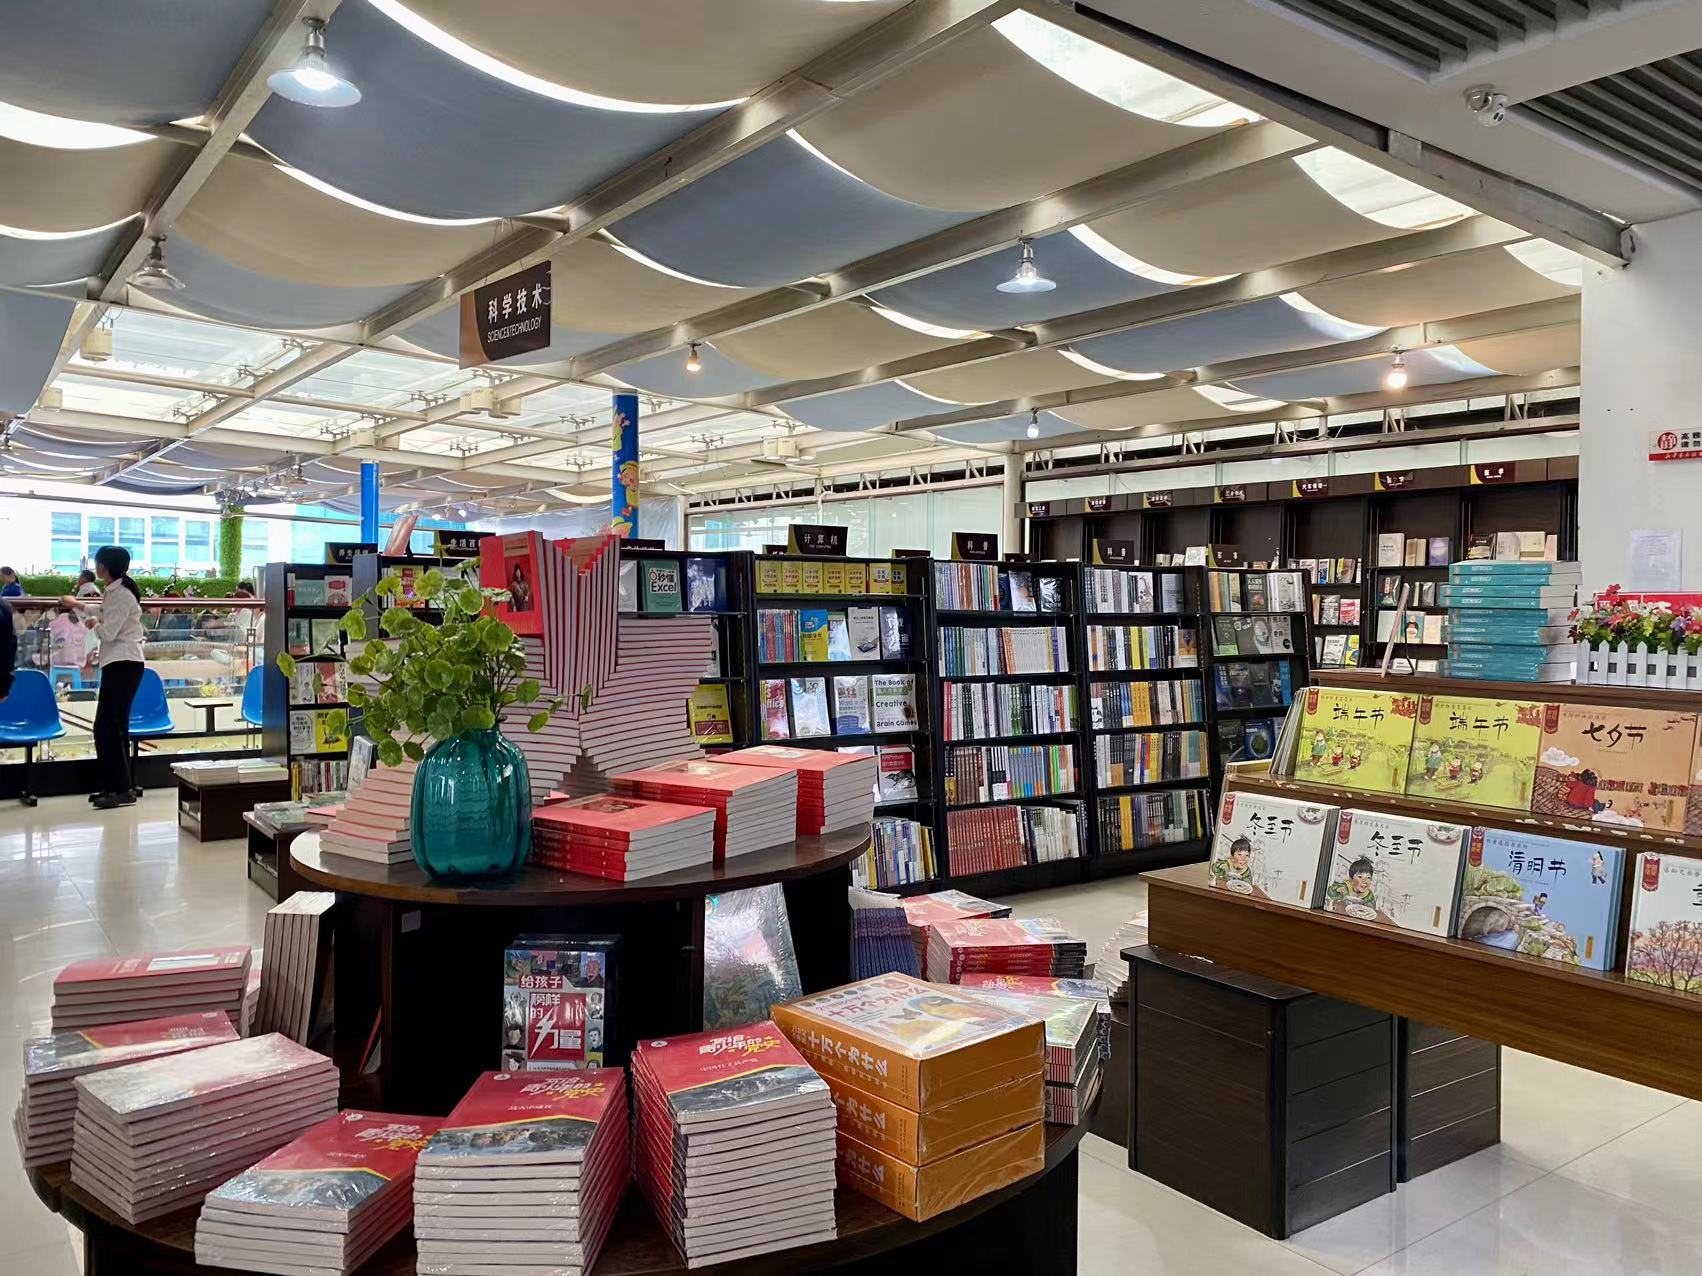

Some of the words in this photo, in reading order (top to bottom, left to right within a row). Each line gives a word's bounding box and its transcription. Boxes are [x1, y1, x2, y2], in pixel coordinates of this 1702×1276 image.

[488, 283, 542, 324] 科学技术
[450, 538, 480, 548] 生活百
[804, 534, 838, 545] 计算机
[651, 581, 677, 593] Excel
[875, 700, 908, 708] Creative
[1333, 703, 1384, 730] 端午节
[876, 719, 895, 727] Brain
[1449, 712, 1509, 740] 端午节
[1581, 721, 1647, 750] 七夕节
[1246, 812, 1294, 844] 冬至节
[1367, 830, 1424, 864] 冬至节
[1508, 850, 1567, 886] 清明节
[520, 975, 562, 988] 给孩子
[530, 993, 560, 1006] 榜样
[829, 986, 930, 1019] 十万个为什么
[530, 1008, 543, 1019] 的
[833, 1092, 886, 1130] 个为什么
